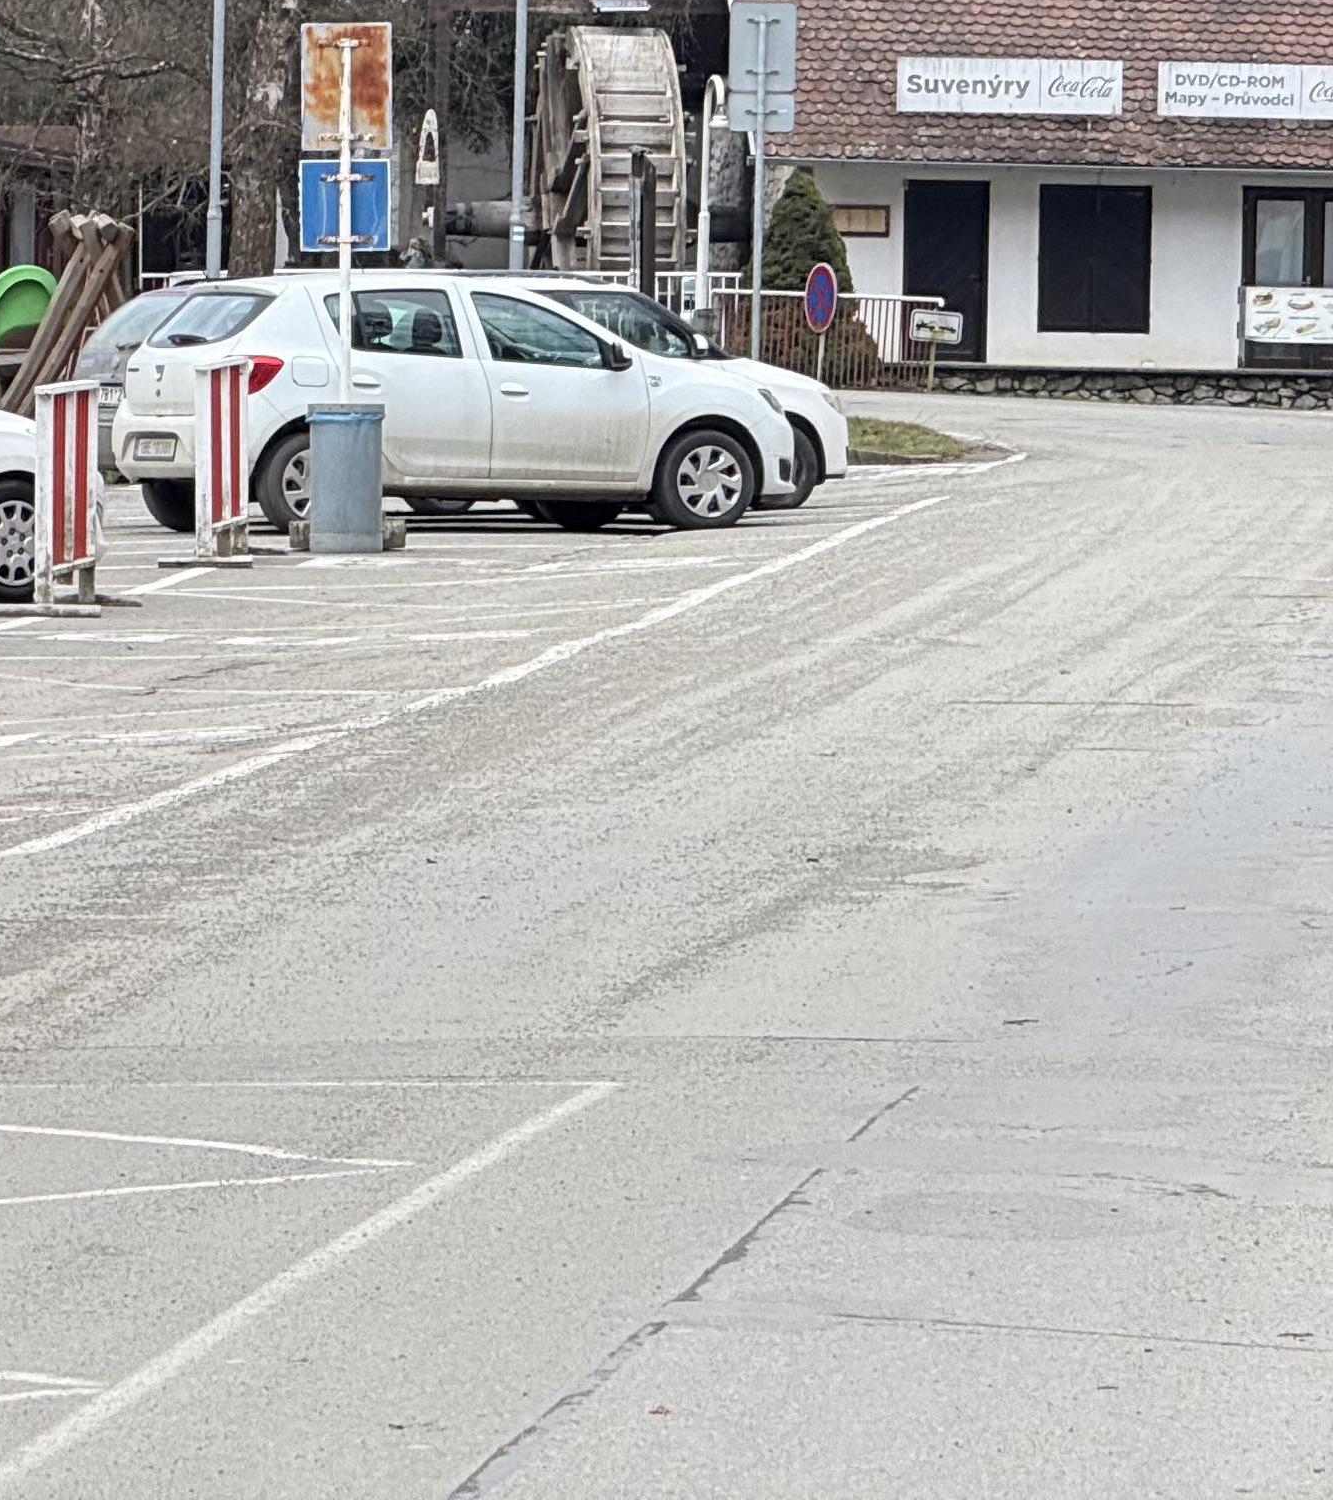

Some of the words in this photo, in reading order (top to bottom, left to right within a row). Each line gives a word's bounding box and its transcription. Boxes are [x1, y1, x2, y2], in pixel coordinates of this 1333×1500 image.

[906, 74, 1030, 99] Suvenýry
[1175, 71, 1285, 89] DVD/CD-ROM
[1164, 91, 1207, 106] Mapy
[1224, 91, 1294, 106] Průvodci
